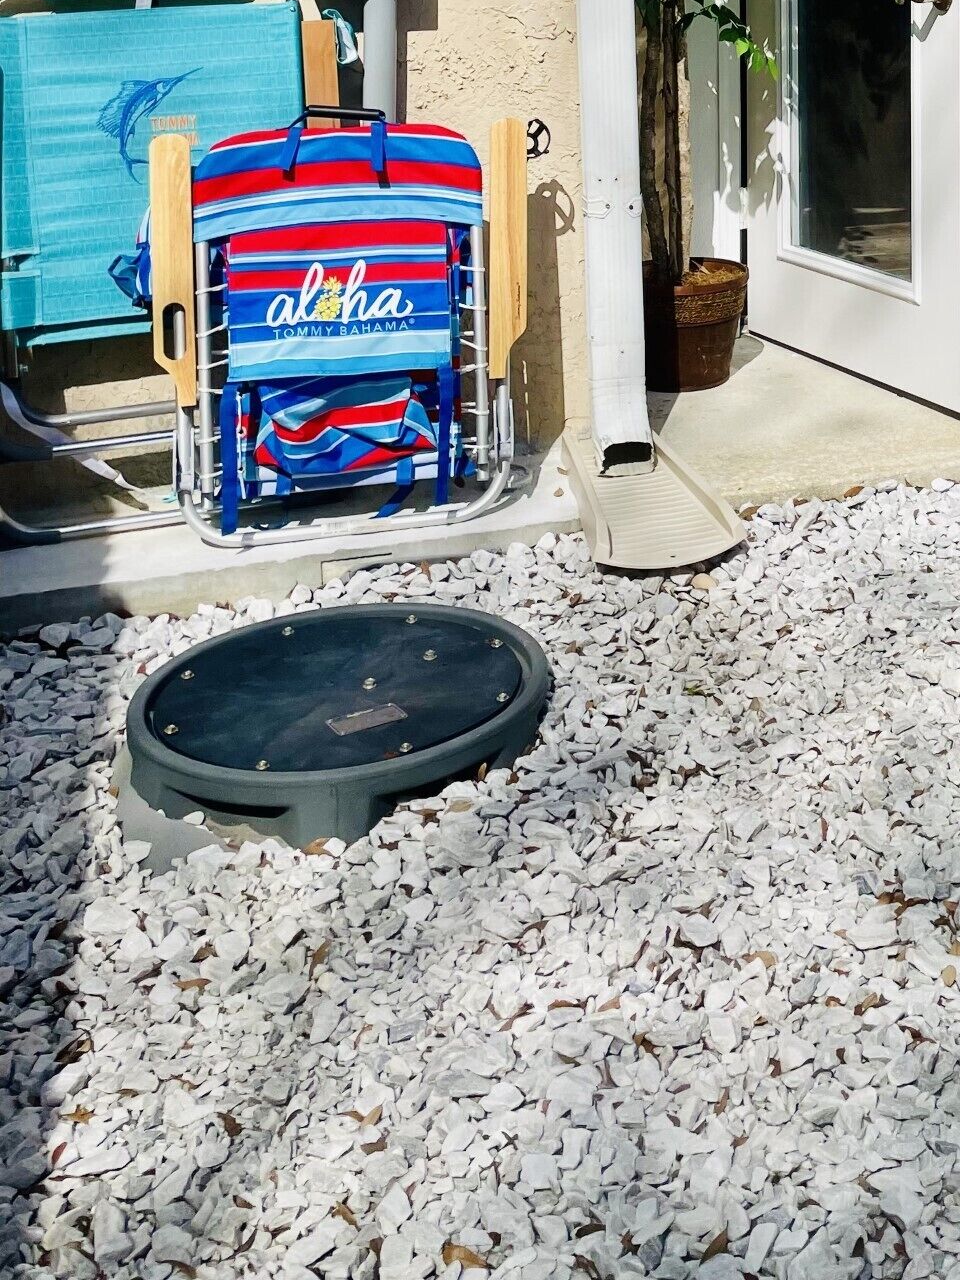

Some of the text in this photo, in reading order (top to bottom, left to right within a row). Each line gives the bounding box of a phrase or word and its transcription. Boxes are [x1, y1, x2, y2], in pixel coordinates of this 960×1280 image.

[151, 115, 196, 131] TOMMY
[266, 259, 414, 327] aloha
[273, 326, 335, 340] TOMMY
